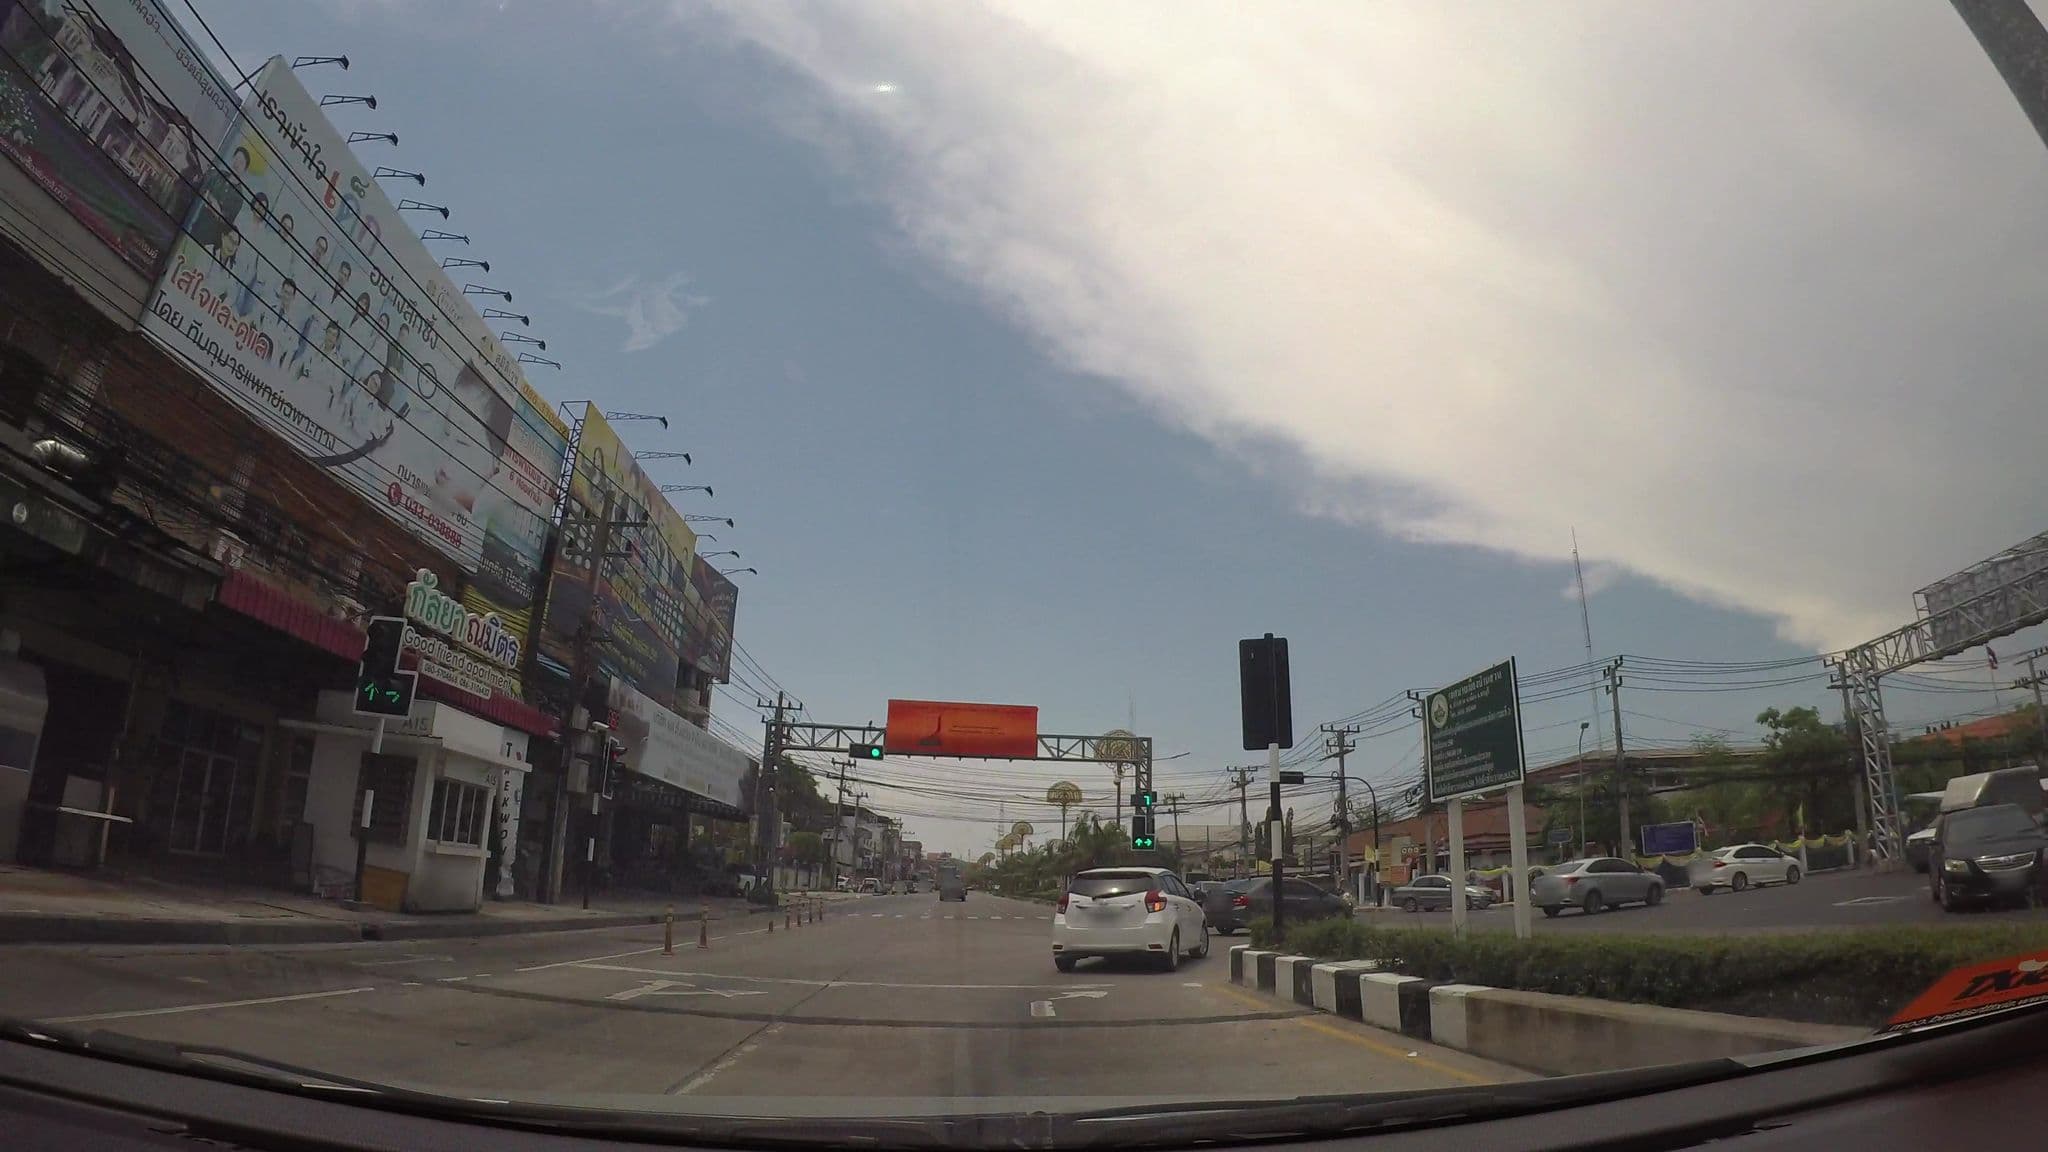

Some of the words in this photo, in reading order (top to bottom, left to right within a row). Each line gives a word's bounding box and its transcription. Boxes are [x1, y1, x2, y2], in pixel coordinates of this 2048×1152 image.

[153, 289, 185, 329] โดย
[171, 255, 274, 361] ใส่ใจและดูแล
[404, 626, 436, 654] Good
[436, 641, 465, 669] friend
[466, 660, 512, 690] apartment
[408, 570, 519, 668] กัลยาณมิตร
